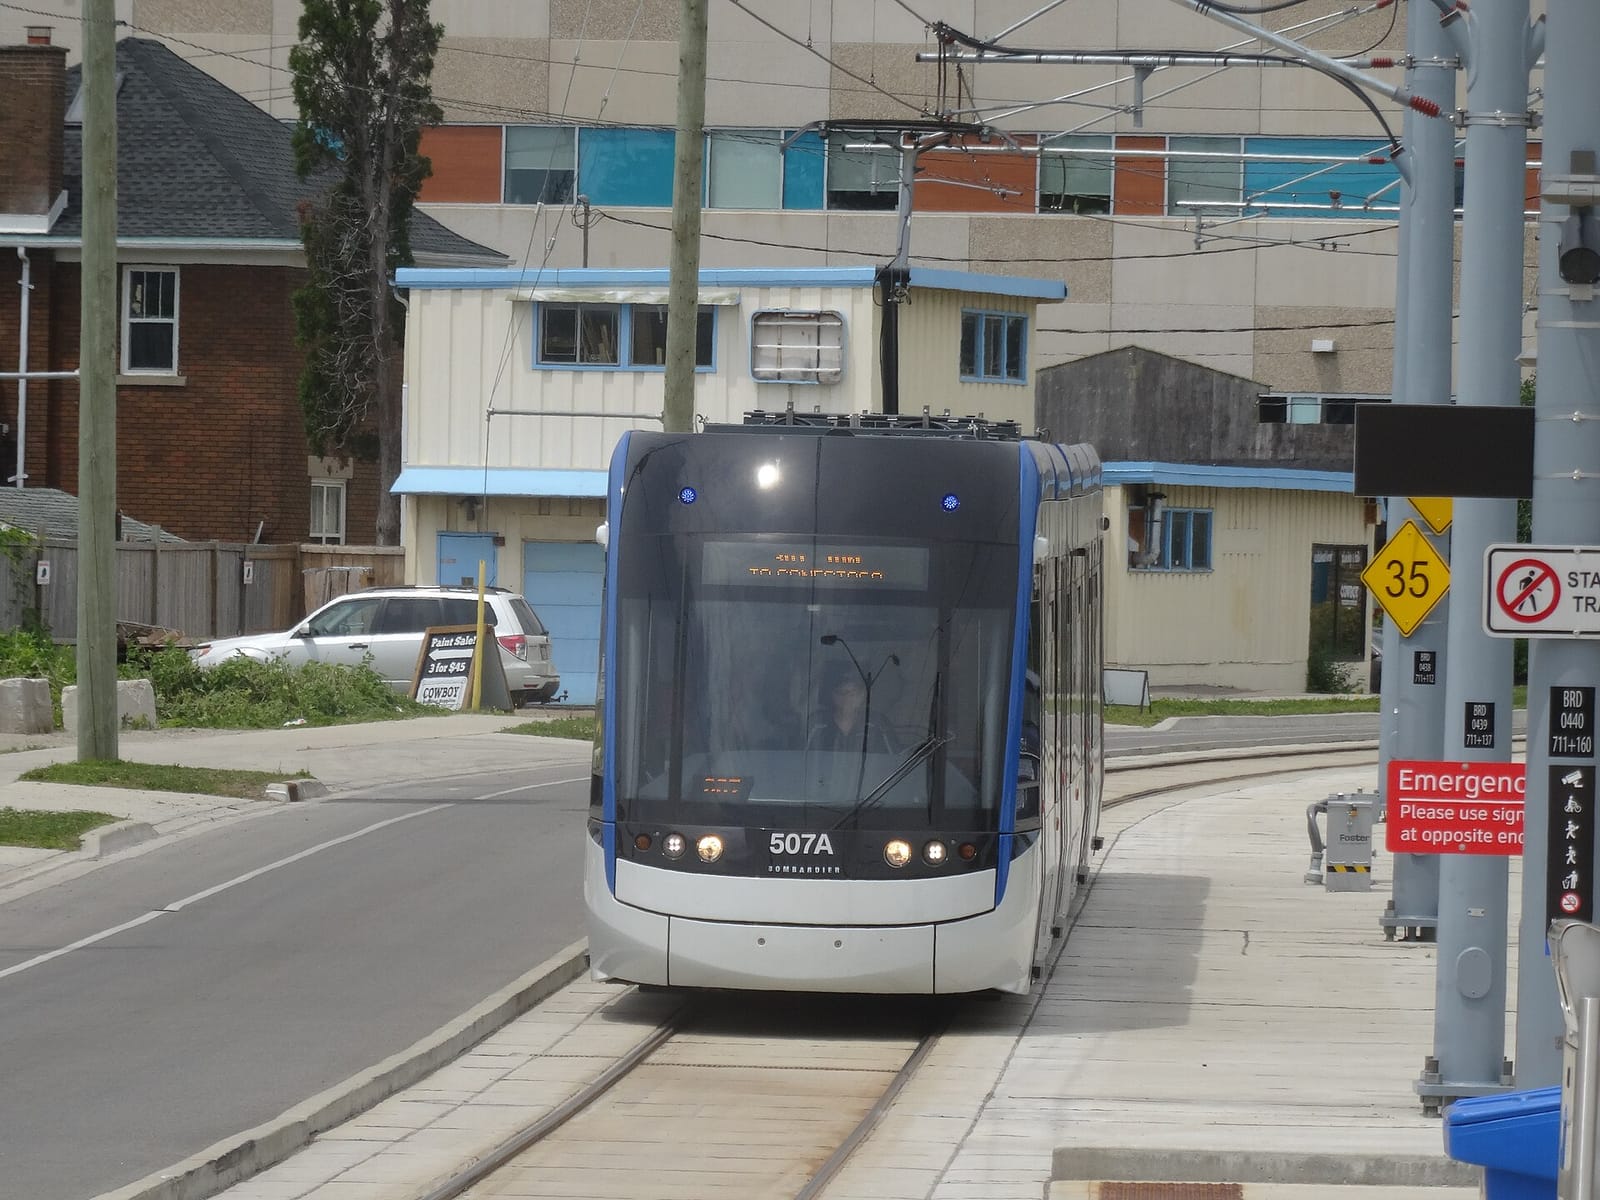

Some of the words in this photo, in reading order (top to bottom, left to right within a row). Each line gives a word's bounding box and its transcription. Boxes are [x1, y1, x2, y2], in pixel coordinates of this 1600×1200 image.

[1385, 559, 1430, 598] 35
[1572, 596, 1600, 613] TR
[431, 637, 453, 648] Paint
[453, 635, 477, 646] Sale!
[428, 664, 435, 673] 3
[435, 662, 448, 672] for
[448, 661, 466, 673] $45
[423, 686, 460, 698] COWBOY
[1563, 690, 1583, 708] BRD
[1473, 704, 1487, 716] BRD
[1471, 719, 1488, 731] 0439
[1560, 712, 1584, 729] 0440
[1466, 734, 1492, 746] 711+137
[1552, 735, 1592, 753] 711+160
[1400, 804, 1454, 820] Please
[1459, 808, 1488, 820] use
[769, 833, 834, 855] 507A
[1400, 827, 1417, 841] at
[1422, 828, 1493, 846] opposite
[767, 865, 841, 874] BOMBARDIER
